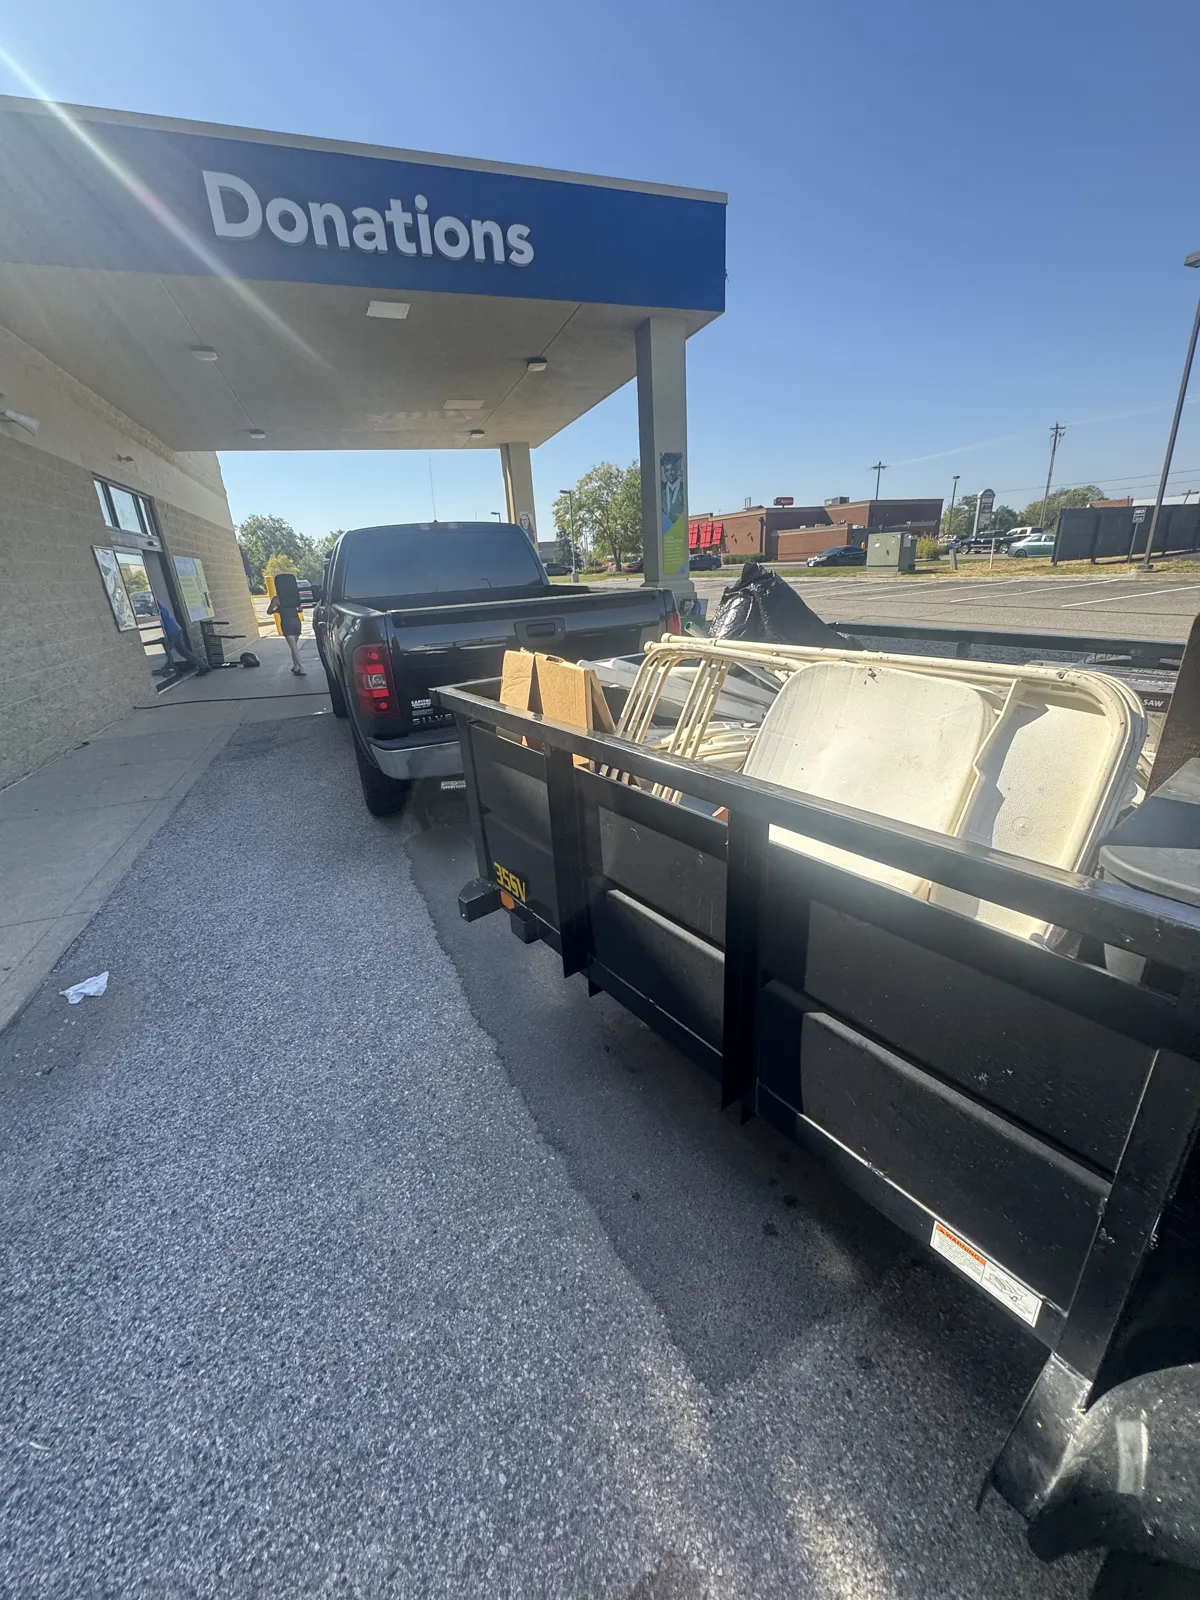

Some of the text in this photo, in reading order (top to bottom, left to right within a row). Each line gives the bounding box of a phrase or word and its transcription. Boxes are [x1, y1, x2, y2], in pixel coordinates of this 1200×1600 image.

[202, 169, 535, 267] Donations
[1143, 699, 1164, 707] SAW
[412, 713, 455, 725] SILVE
[944, 1230, 980, 1261] WARNING
